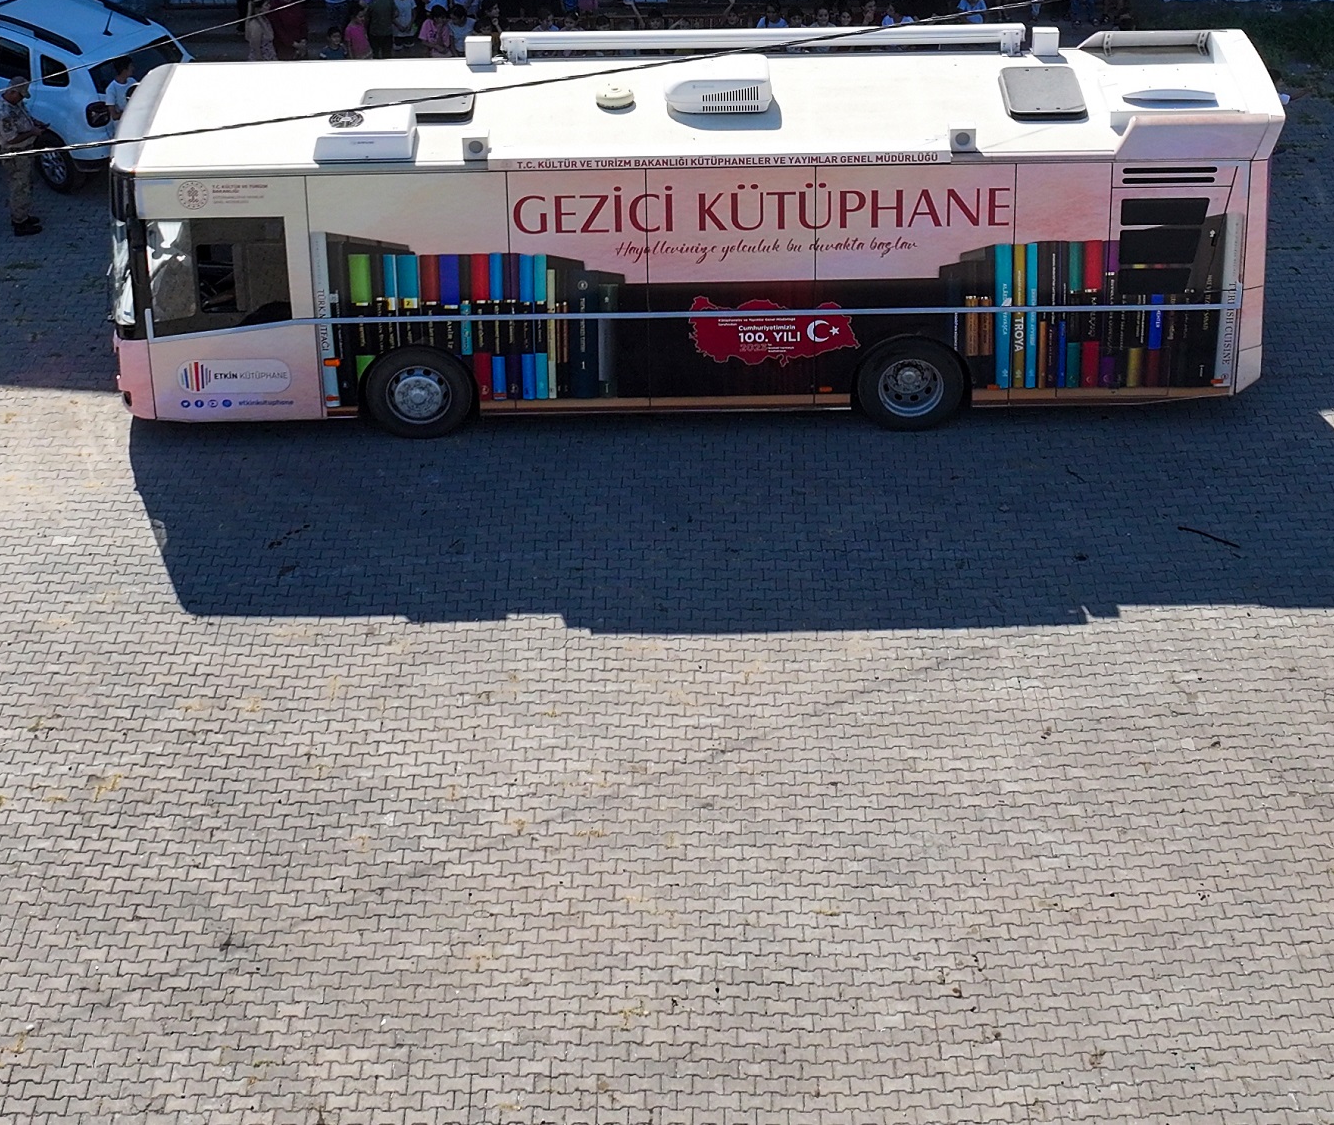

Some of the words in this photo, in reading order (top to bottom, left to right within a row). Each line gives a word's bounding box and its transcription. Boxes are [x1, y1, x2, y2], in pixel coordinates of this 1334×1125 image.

[517, 161, 536, 169] T.C.
[537, 159, 577, 169] KÜLTÜR
[579, 160, 592, 168] VE
[595, 158, 632, 168] TURİZM
[634, 156, 688, 167] BAKANLIĞI
[690, 155, 771, 166] KÜTÜPHANELER
[773, 156, 786, 165] VE
[788, 155, 838, 165] YAYIMLAR
[840, 155, 873, 163] GENEL
[875, 152, 938, 163] MÜDÜRLÜĞÜ
[513, 185, 674, 234] GEZİCİ
[698, 182, 1011, 232] KÜTÜPHANE
[721, 237, 780, 262] yolculuk
[786, 237, 802, 253] bu
[738, 331, 768, 343] 100.
[773, 331, 801, 342] YILI
[1014, 316, 1024, 352] TROYA
[739, 343, 768, 352] 2023
[1221, 326, 1234, 366] CUISINE
[239, 371, 288, 380] KÜTÜPHANE
